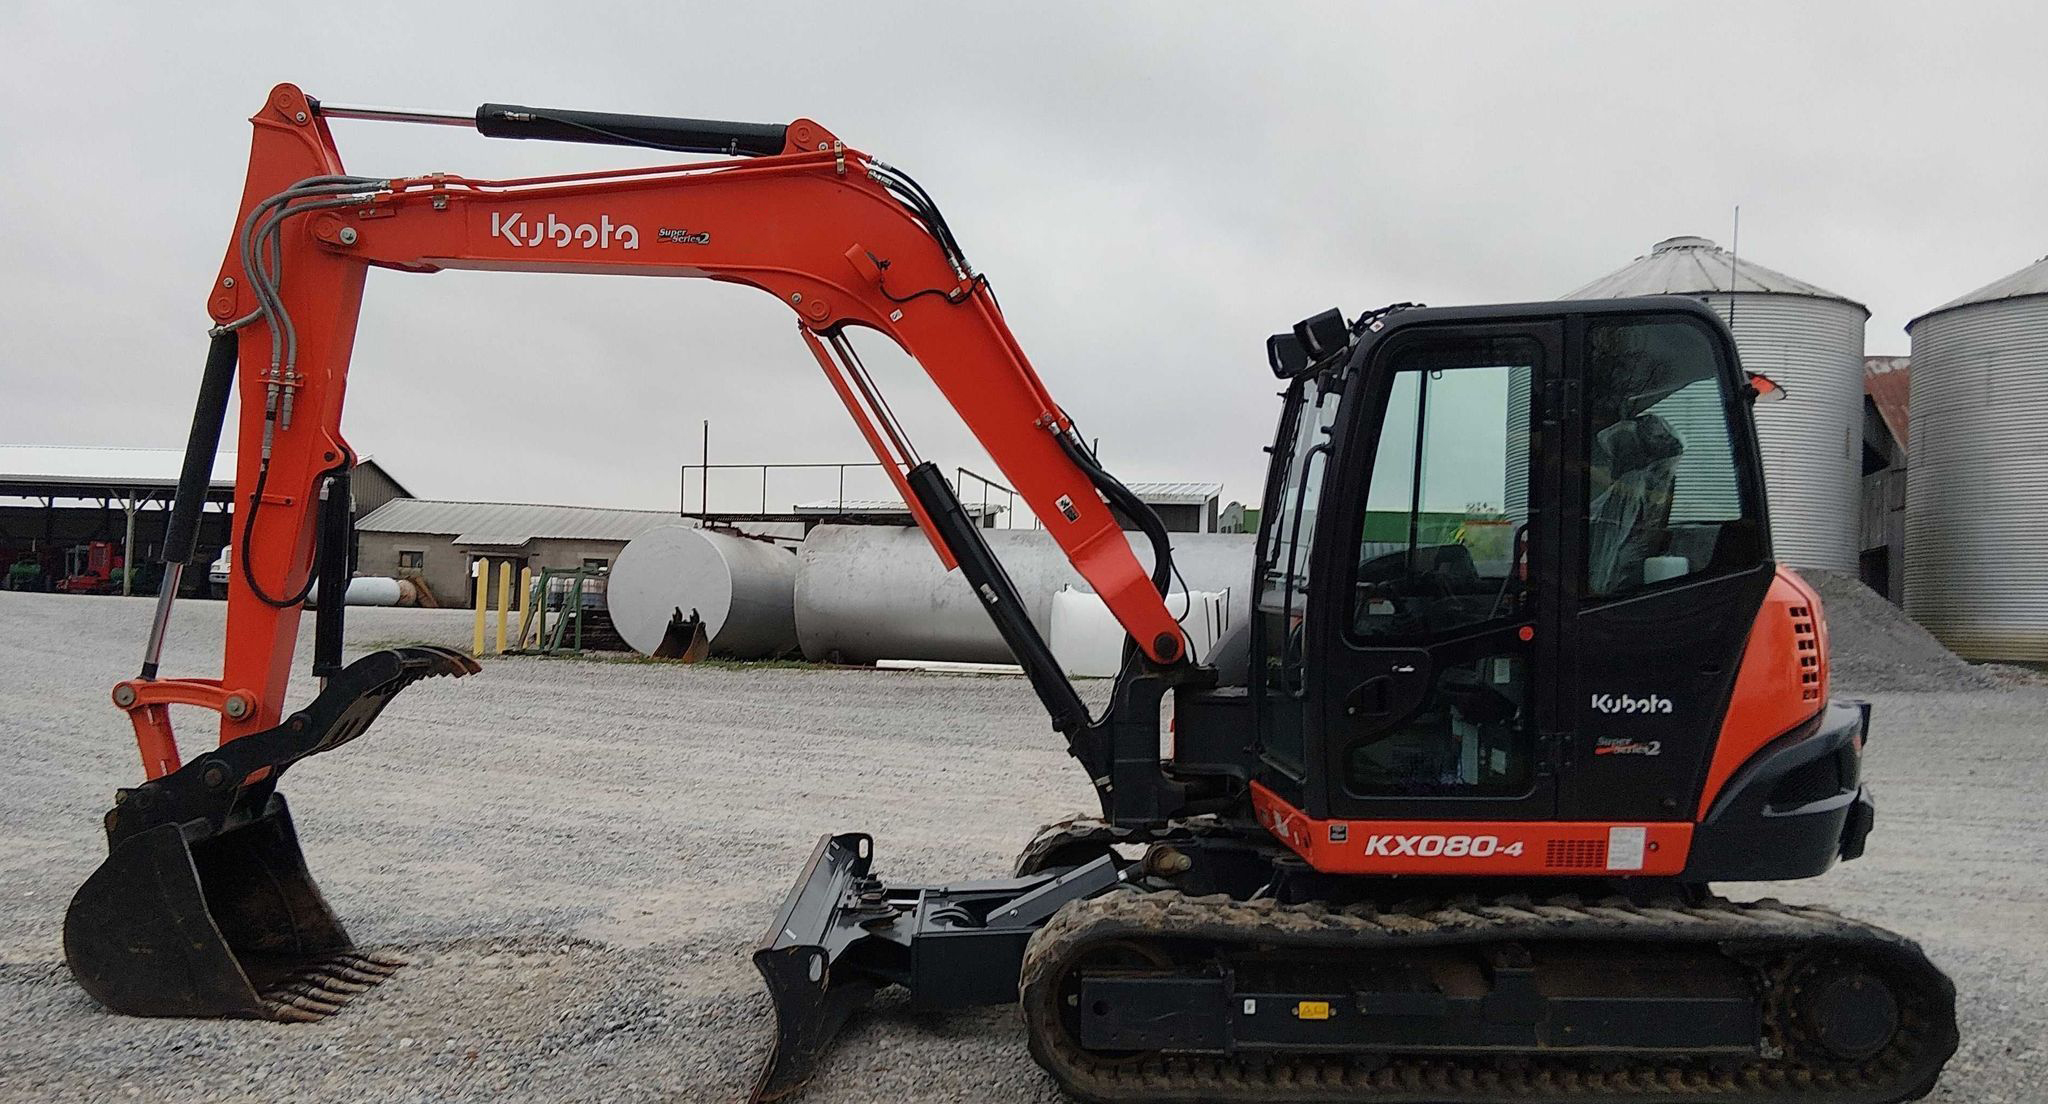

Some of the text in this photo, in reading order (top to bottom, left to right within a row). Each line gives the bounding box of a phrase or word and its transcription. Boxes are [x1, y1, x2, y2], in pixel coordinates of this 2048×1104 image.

[492, 212, 639, 249] Kubota
[658, 228, 687, 238] Super
[1591, 694, 1673, 713] Kubota
[1364, 835, 1524, 857] KX080-4
